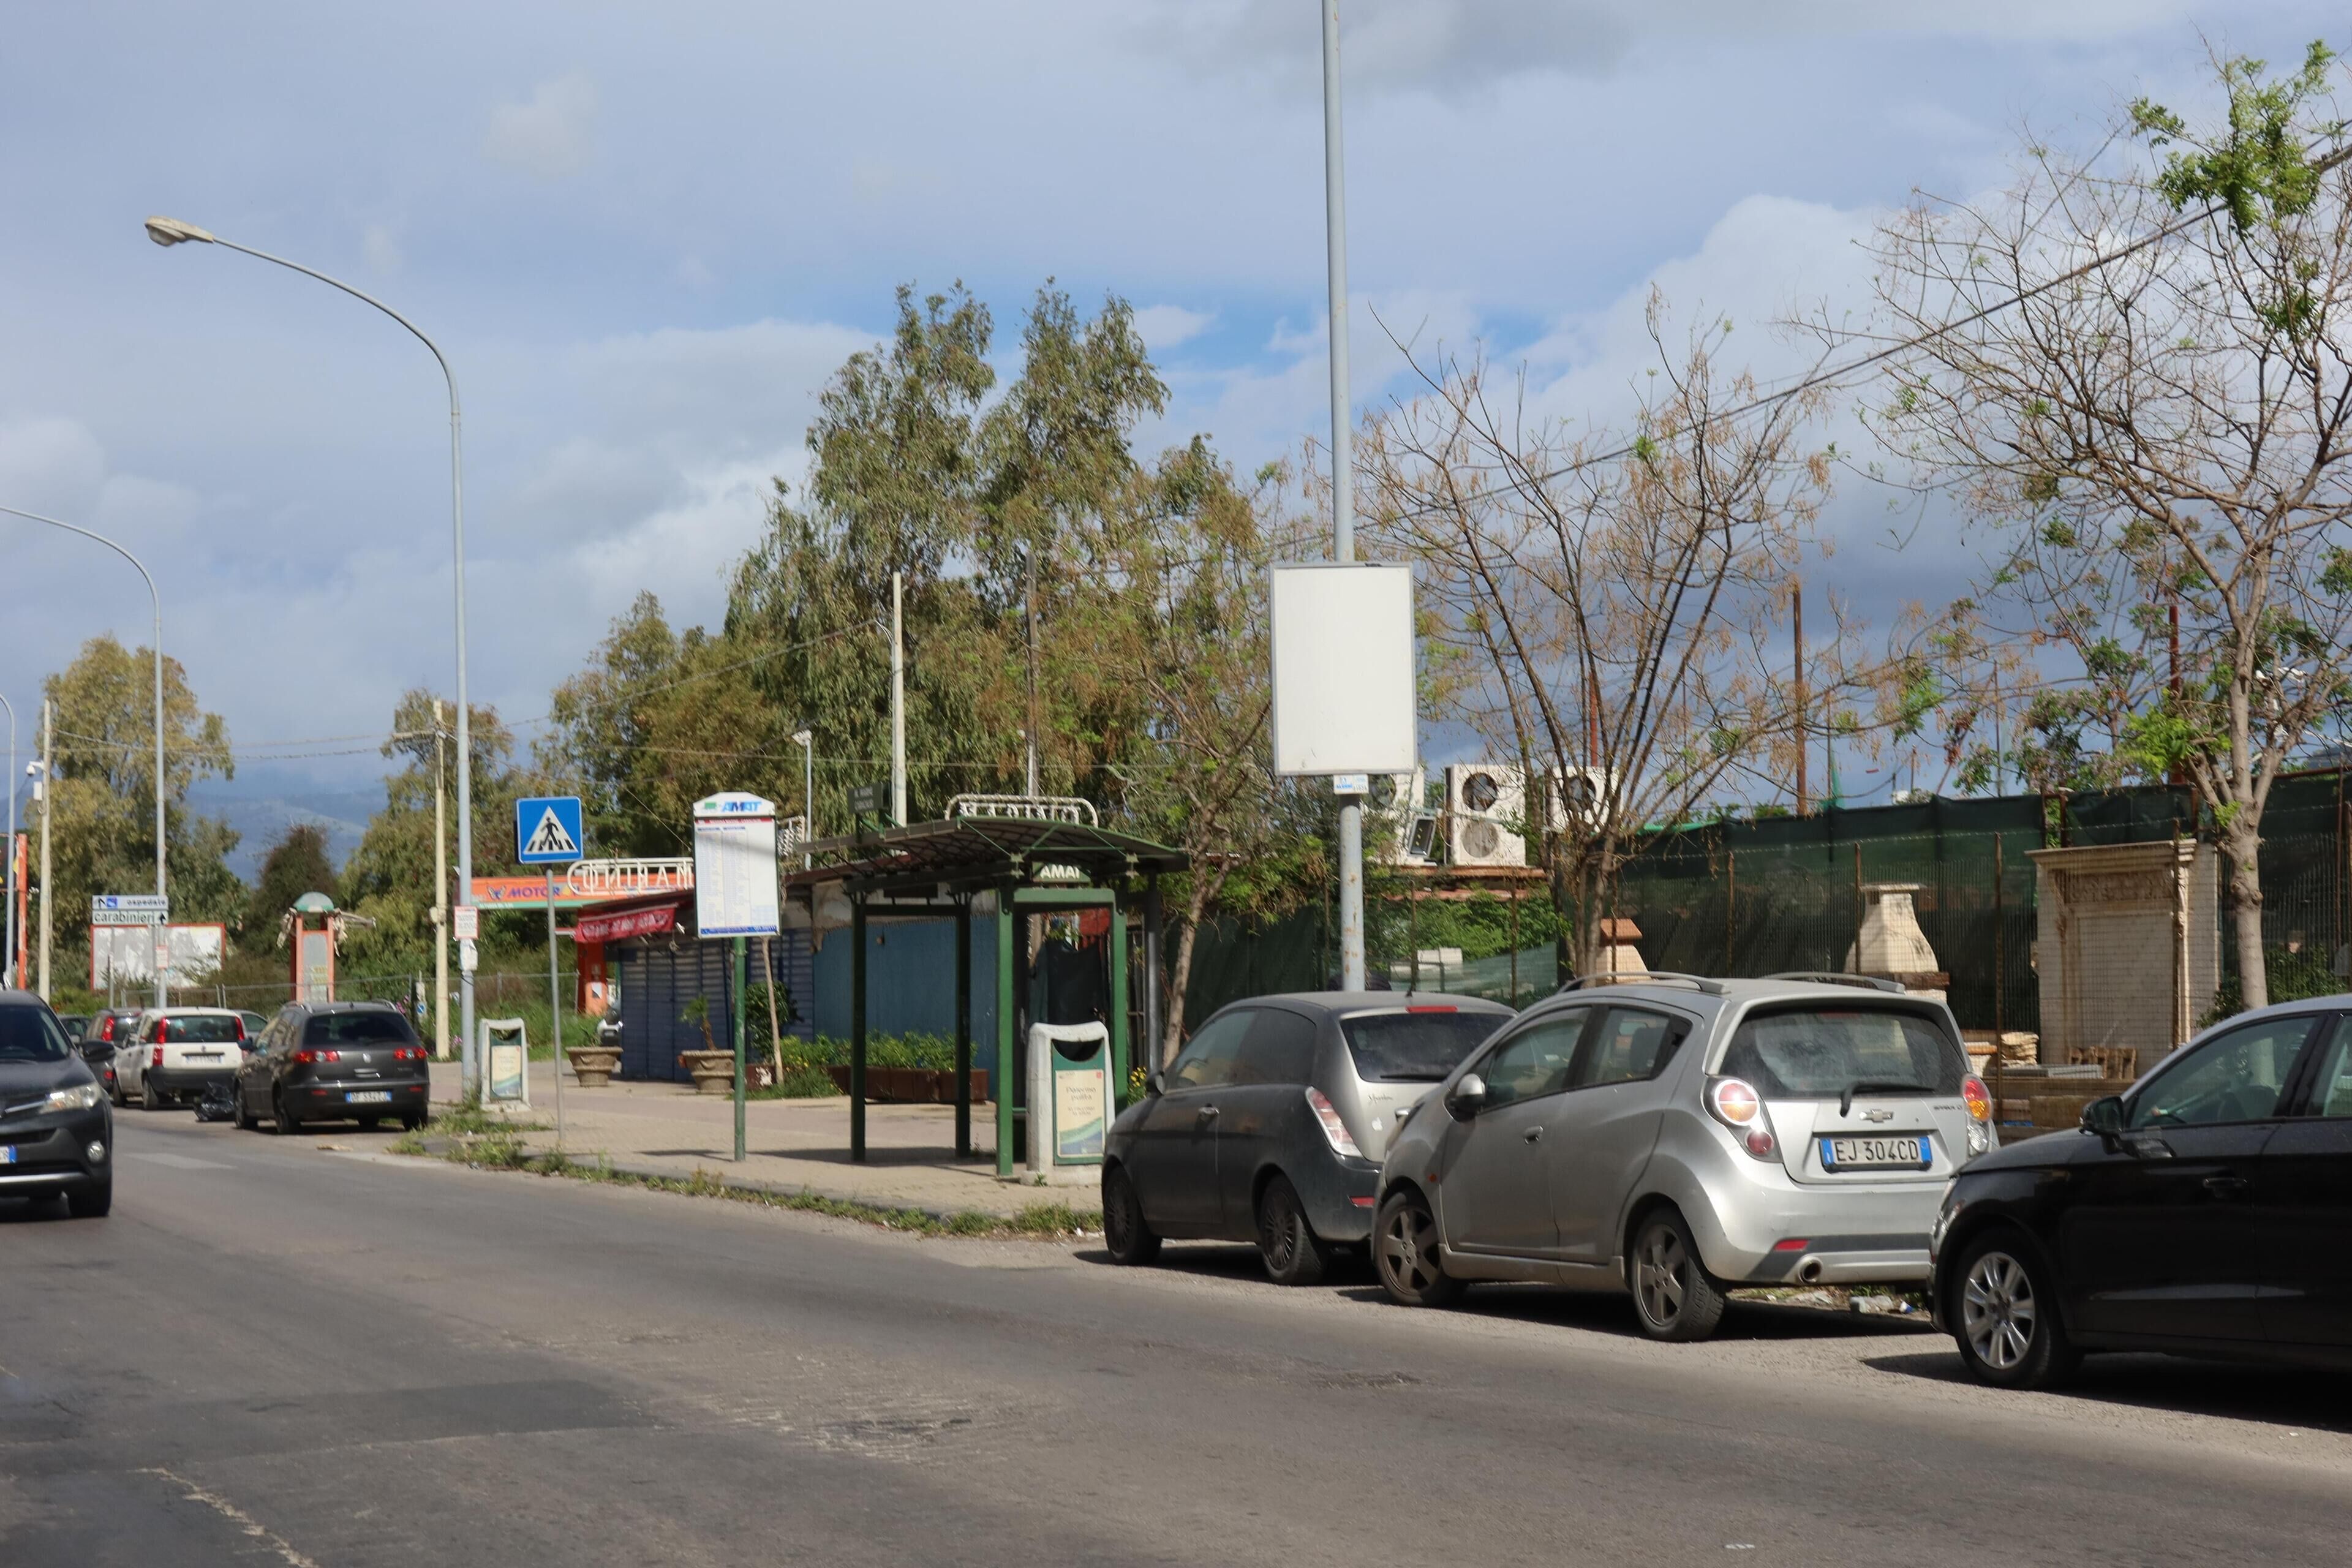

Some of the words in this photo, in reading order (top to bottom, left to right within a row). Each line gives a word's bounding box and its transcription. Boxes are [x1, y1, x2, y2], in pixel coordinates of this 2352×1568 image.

[722, 801, 761, 812] AMAT
[94, 910, 155, 923] carabinieri
[1834, 1141, 1857, 1162] EJ
[1863, 1140, 1919, 1161] 304CD
